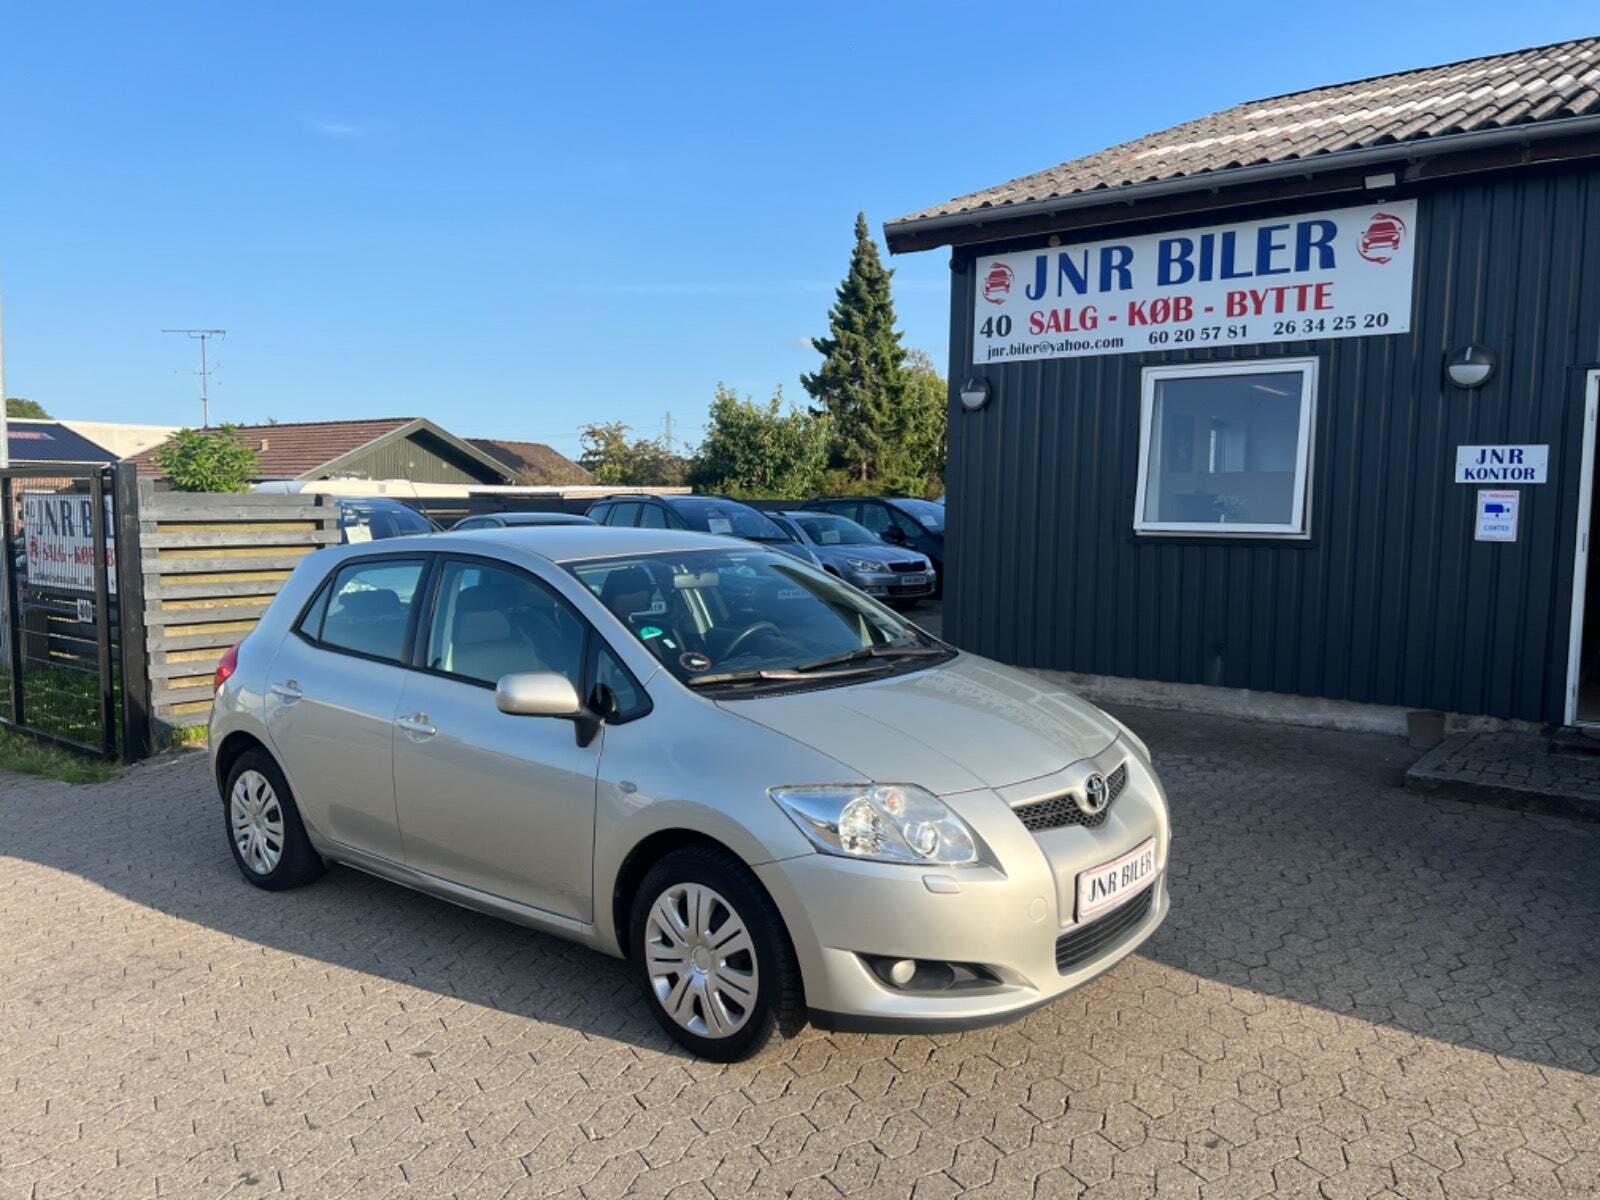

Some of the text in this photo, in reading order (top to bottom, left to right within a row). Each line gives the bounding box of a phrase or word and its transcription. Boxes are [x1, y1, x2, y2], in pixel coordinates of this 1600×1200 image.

[1025, 218, 1338, 300] JNR BILER
[1029, 304, 1098, 335] SALG
[1128, 296, 1194, 326] KØB
[1226, 281, 1335, 318] BYTTE
[980, 314, 1012, 338] 40
[1148, 324, 1248, 345] 60 20 57 81
[1273, 312, 1389, 335] 26 34 25 20
[987, 336, 1124, 360] jnr.biler@yahoo.com
[1475, 448, 1524, 465] JNR
[1464, 467, 1536, 480] KONTOR
[1088, 850, 1152, 903] JNR BILER
